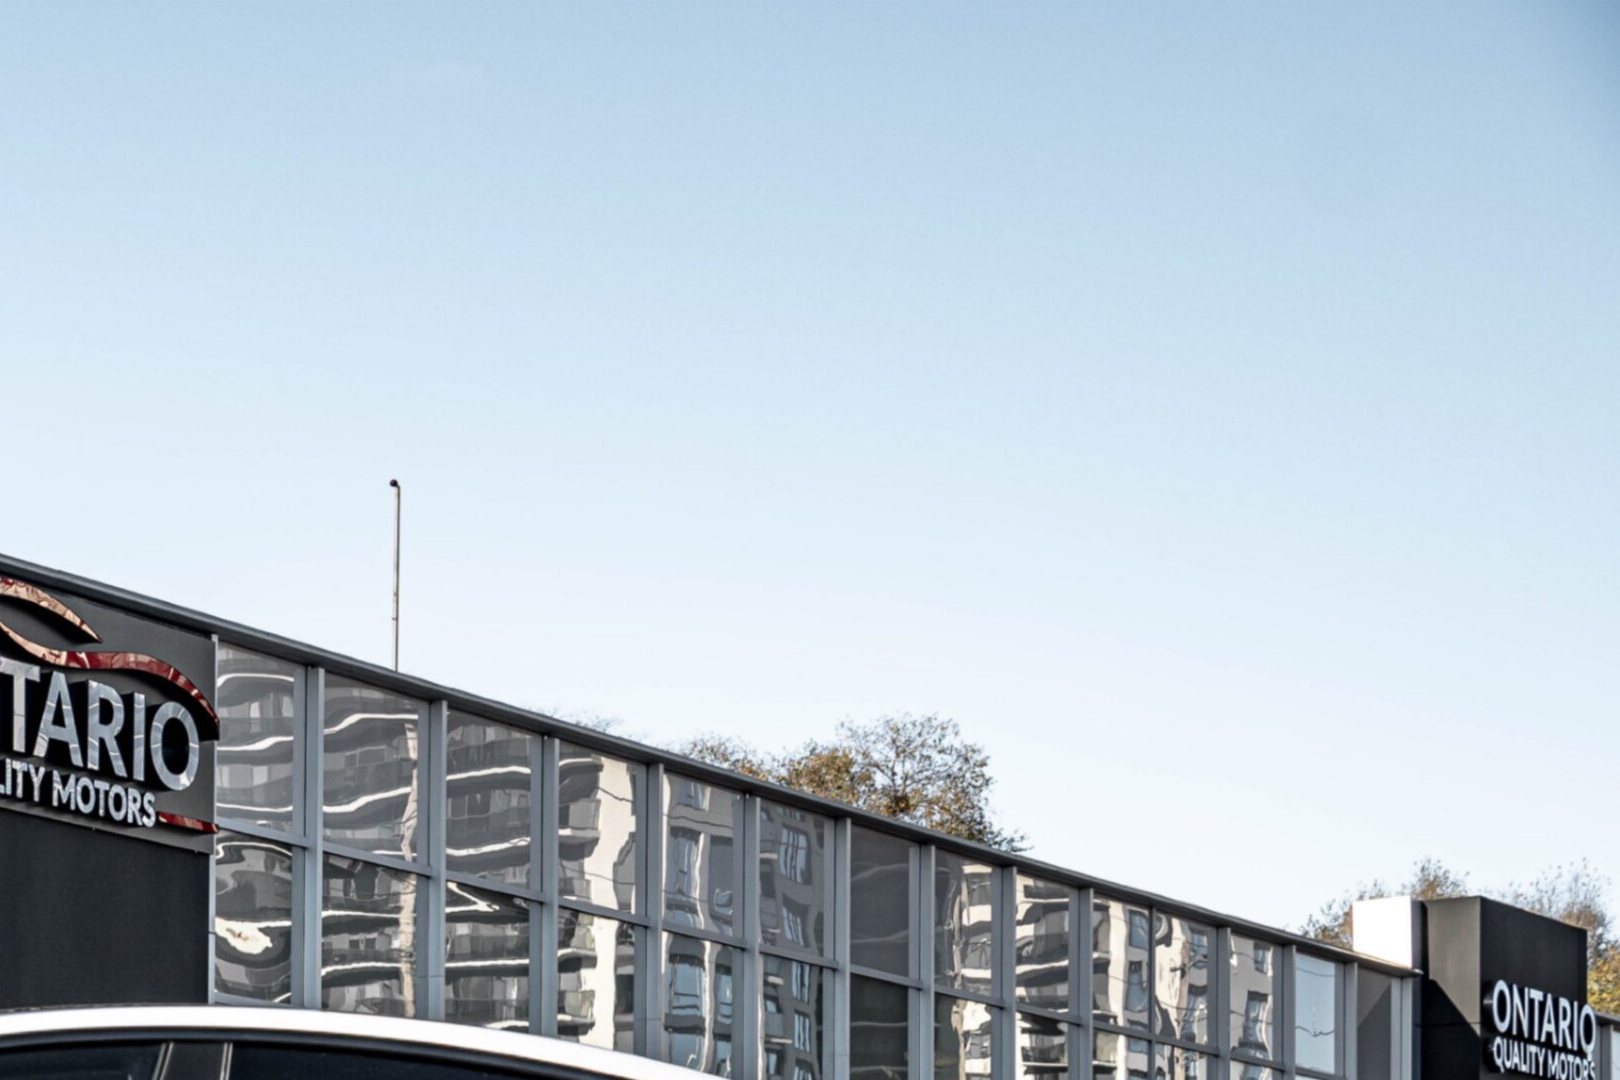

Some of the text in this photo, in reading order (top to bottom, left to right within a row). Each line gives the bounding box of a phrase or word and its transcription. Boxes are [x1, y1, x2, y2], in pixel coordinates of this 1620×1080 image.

[52, 769, 157, 828] MOTORS
[1492, 979, 1596, 1054] ONTARIO
[1493, 1036, 1546, 1077] QUALITY
